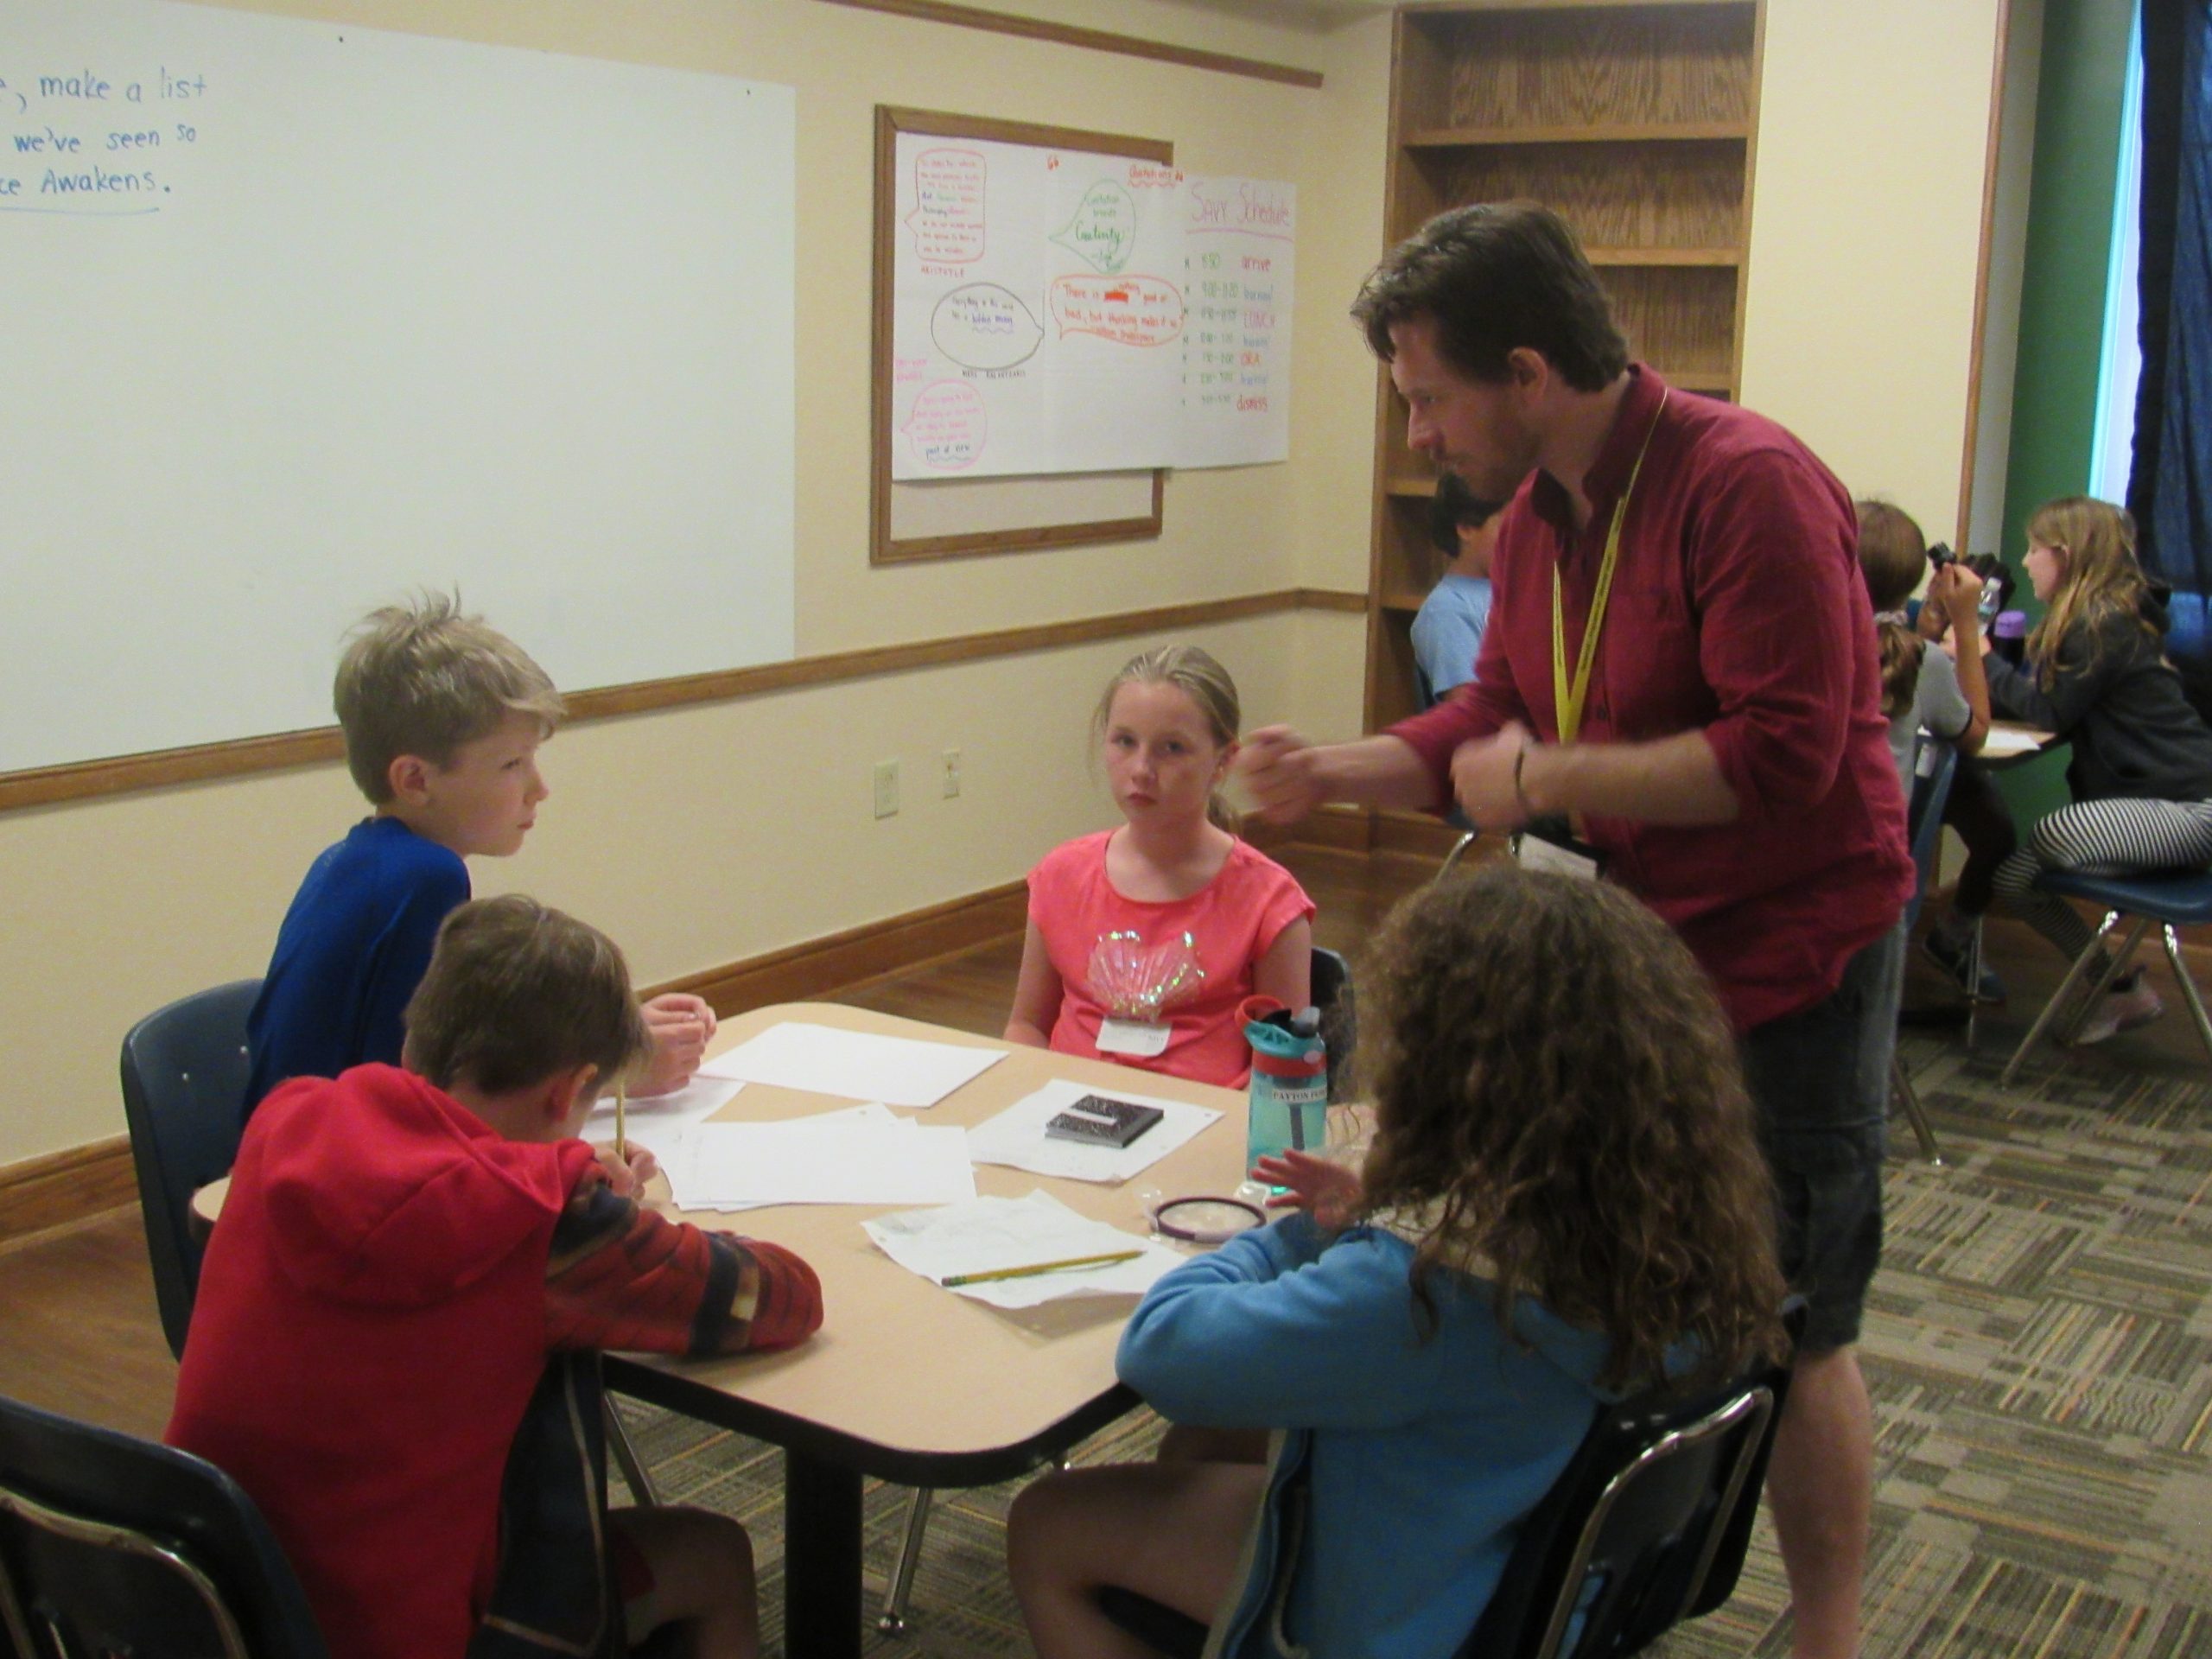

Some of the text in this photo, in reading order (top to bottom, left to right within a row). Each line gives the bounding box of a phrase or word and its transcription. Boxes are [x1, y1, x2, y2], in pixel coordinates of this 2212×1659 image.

[40, 69, 111, 99] make
[126, 83, 142, 103] a
[160, 66, 207, 99] list
[14, 124, 197, 153] we've seen so
[41, 165, 171, 194] Awakens.
[1236, 181, 1291, 226] Schedule
[1243, 256, 1271, 271] arrive
[1274, 1091, 1308, 1101] PAYTON
